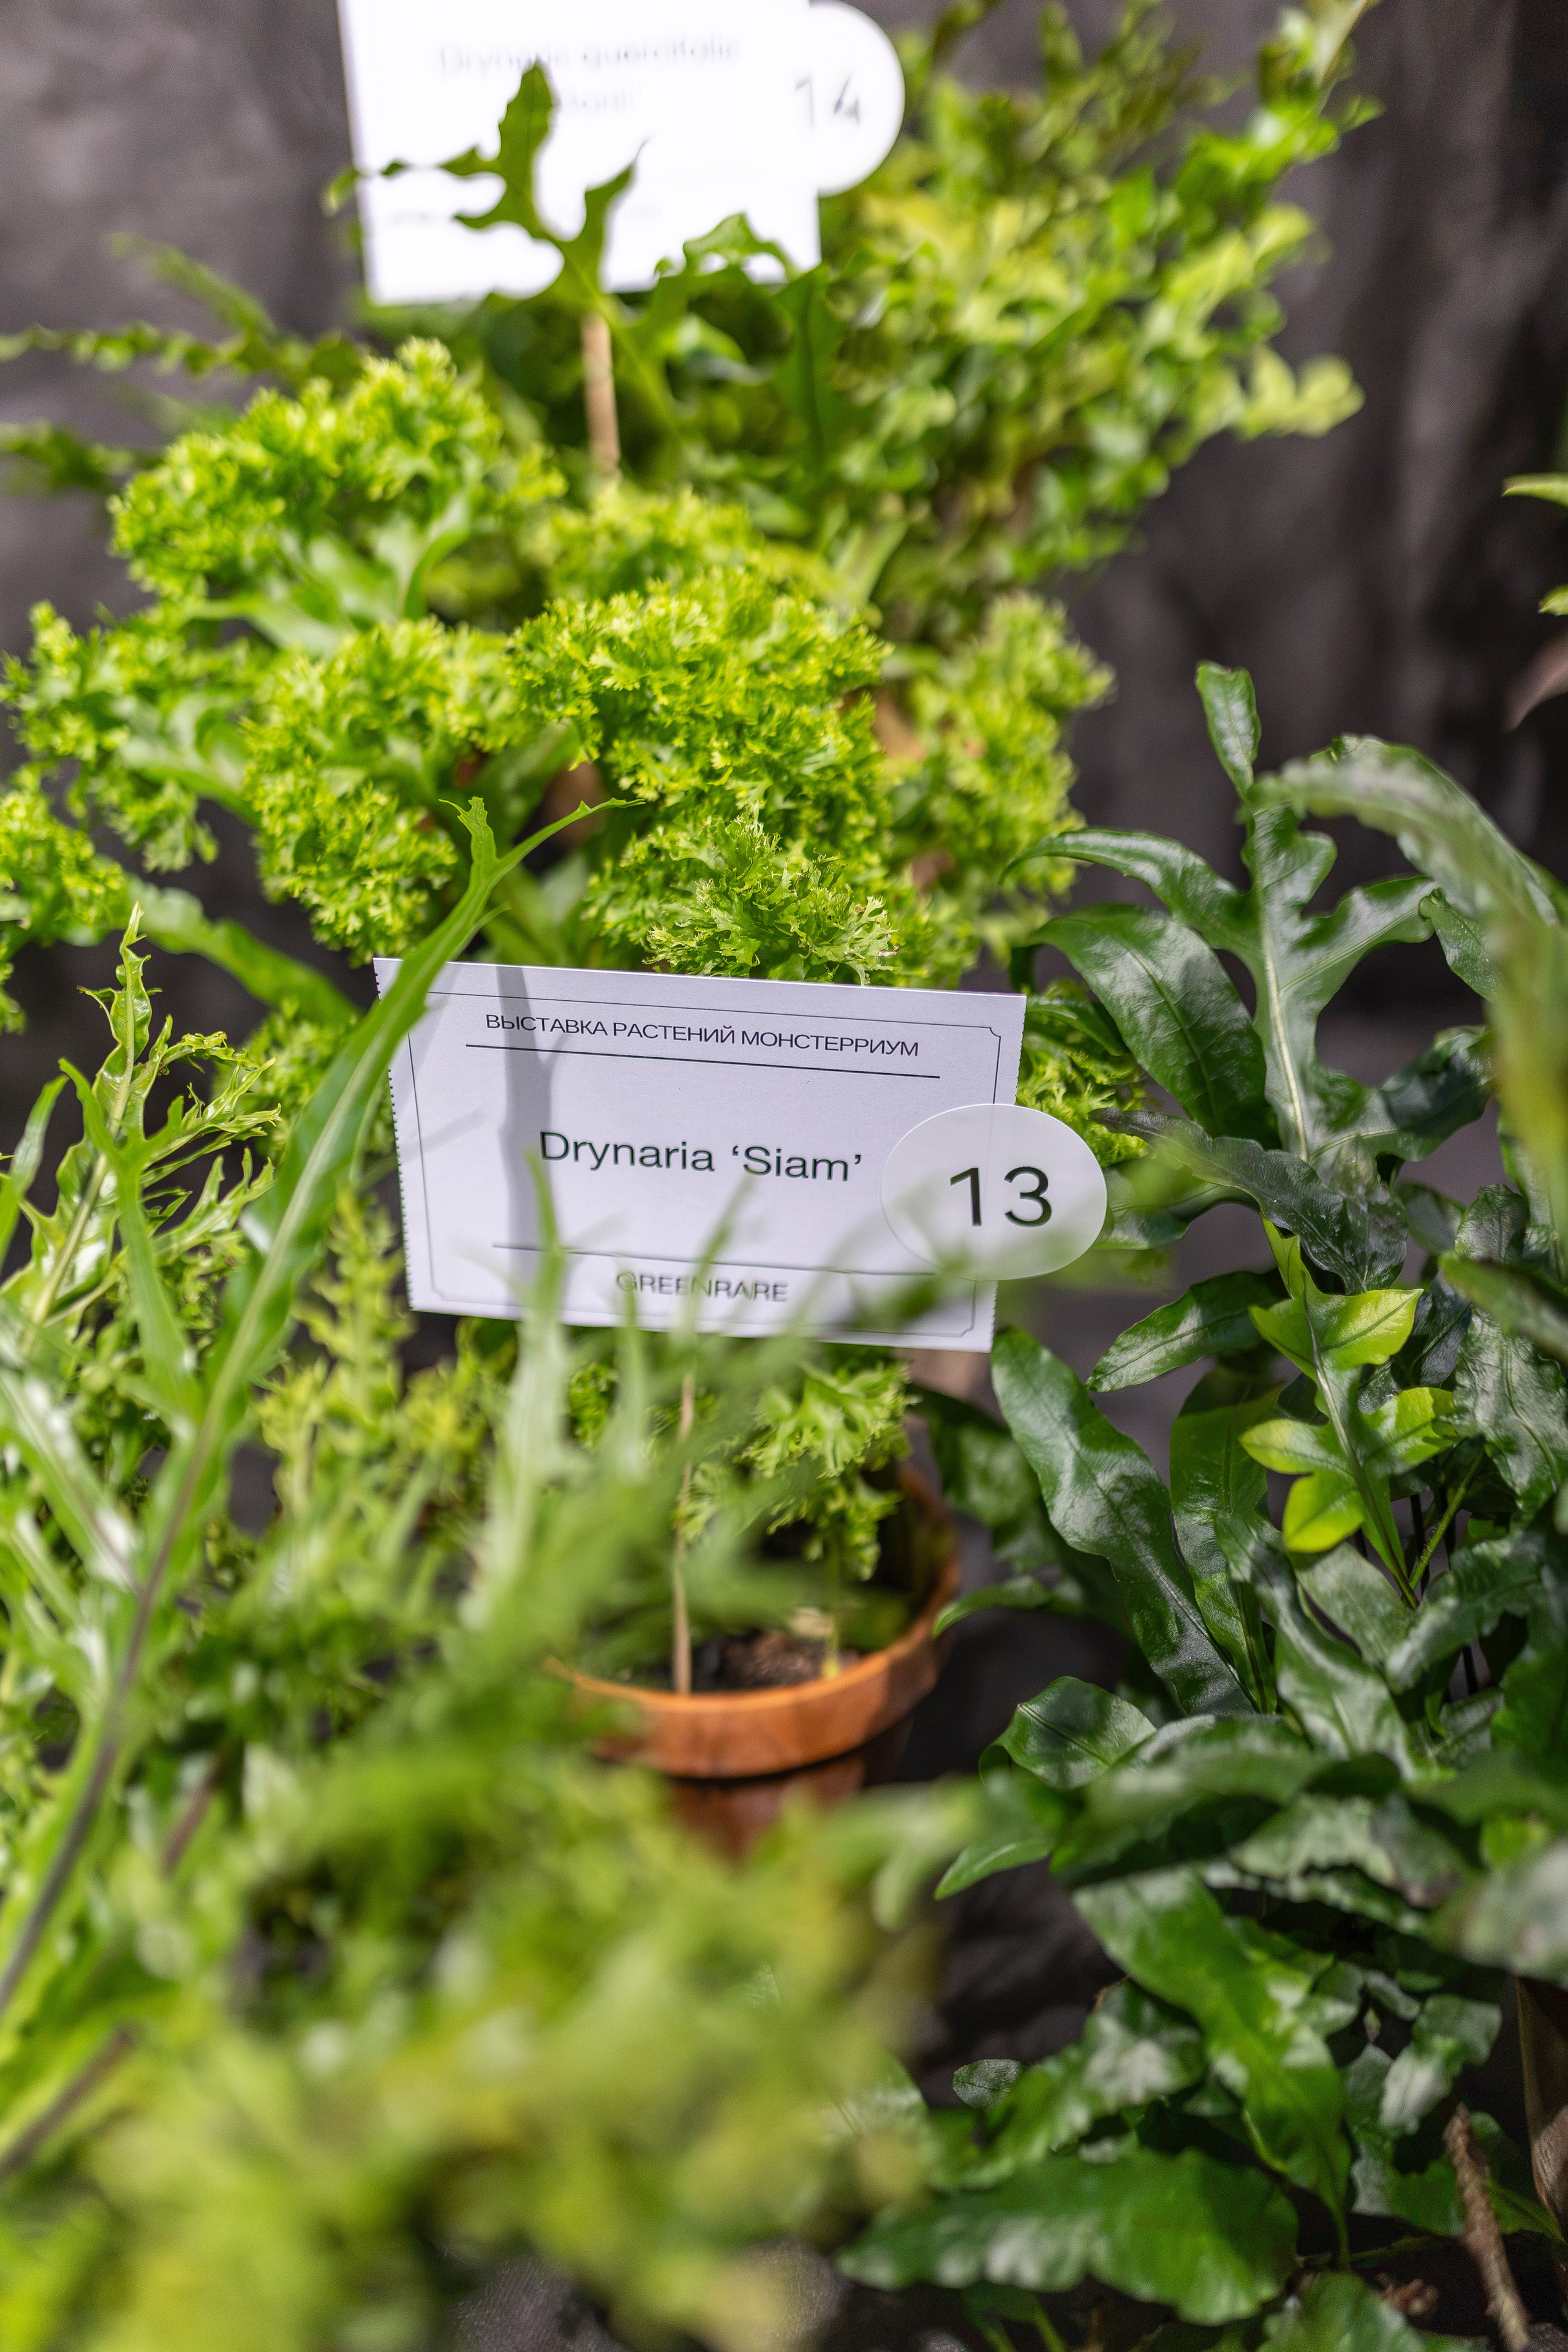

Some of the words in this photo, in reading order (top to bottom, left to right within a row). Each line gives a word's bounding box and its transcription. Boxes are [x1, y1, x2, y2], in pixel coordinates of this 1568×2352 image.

[795, 70, 861, 127] 14
[486, 1014, 608, 1036] ВЫСТАВКА
[612, 1022, 735, 1045] РАСТЕНИЙ
[741, 1030, 919, 1057] МОНСТЕРРИУМ
[539, 1131, 715, 1172] Drynaria
[949, 1166, 1053, 1227] 13
